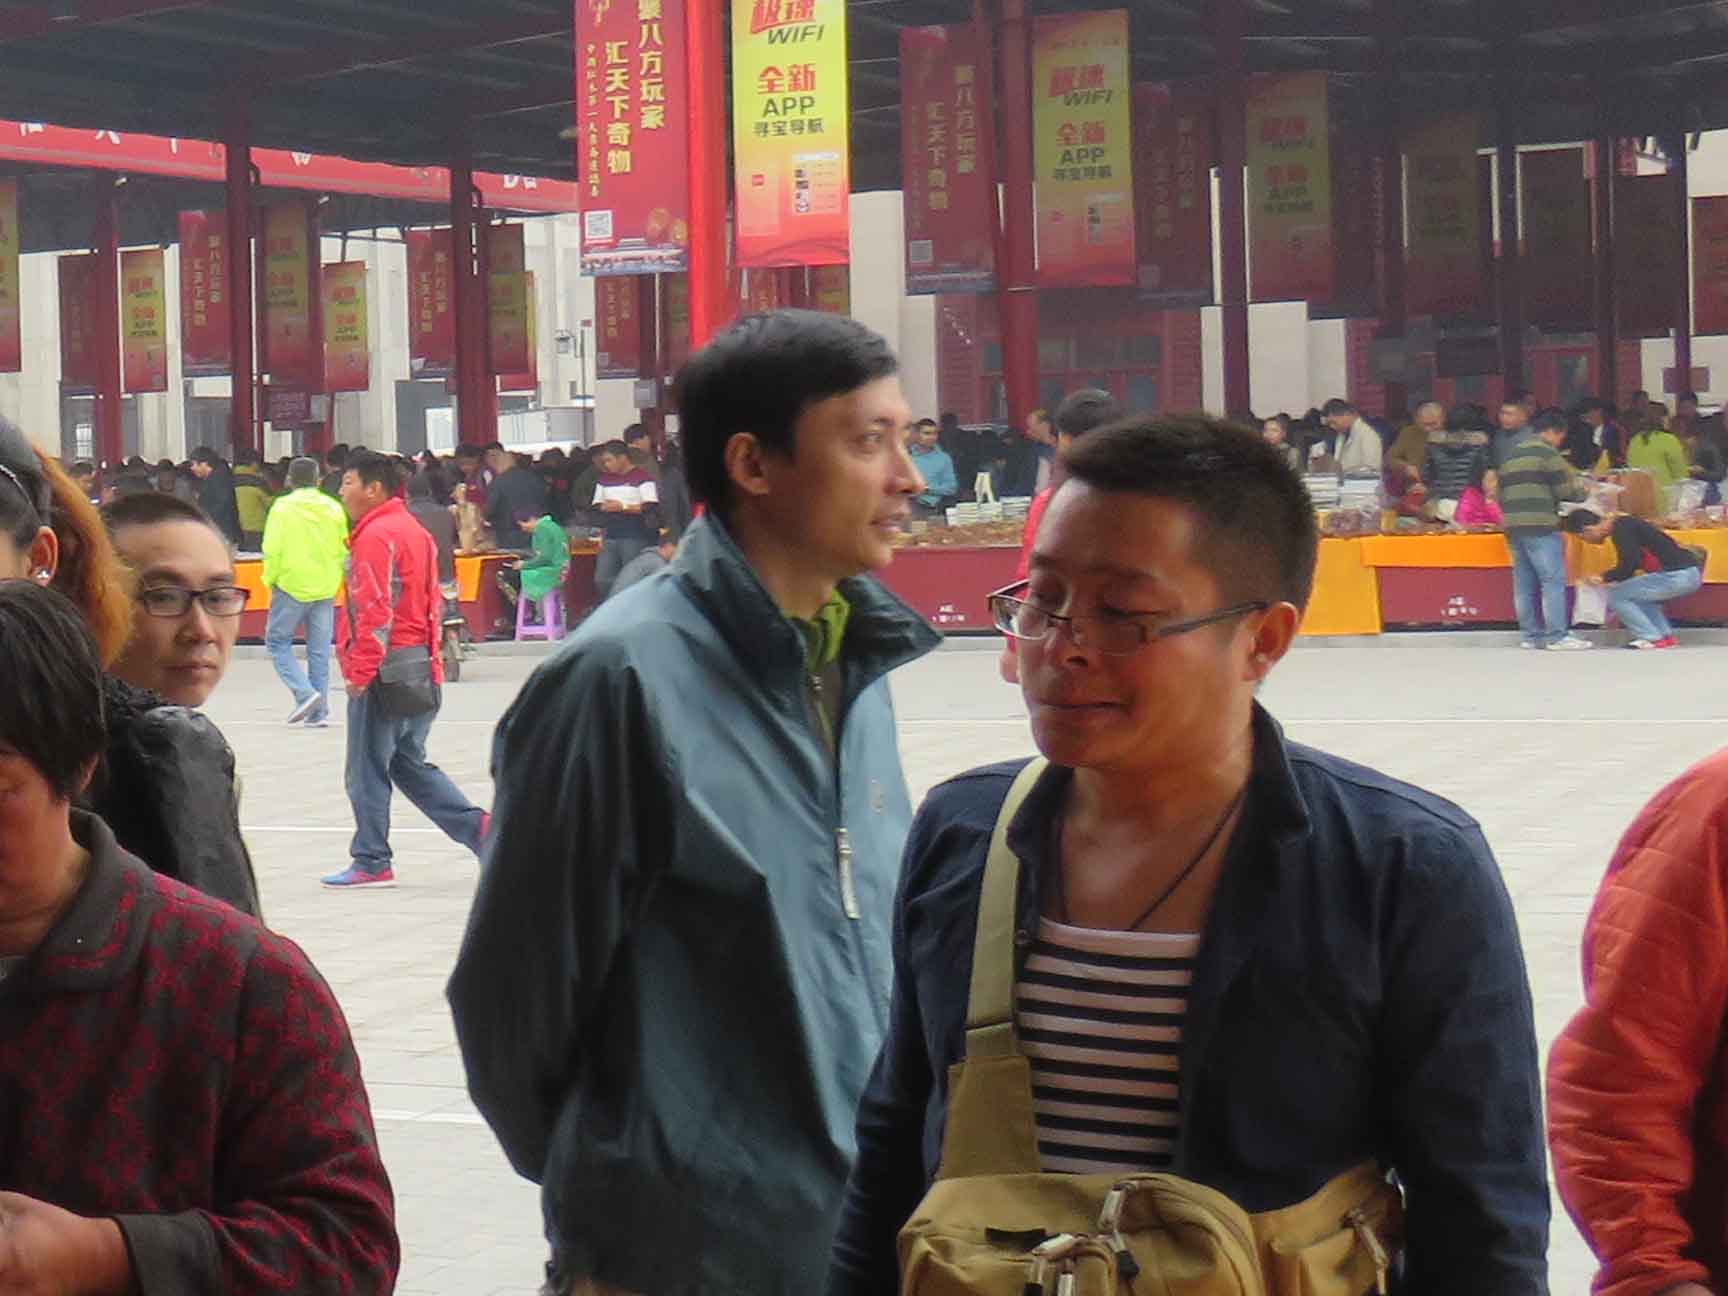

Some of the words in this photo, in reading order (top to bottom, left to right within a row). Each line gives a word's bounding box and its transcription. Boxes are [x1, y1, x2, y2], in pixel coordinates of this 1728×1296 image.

[766, 24, 825, 46] WIFI
[757, 63, 817, 95] 全新
[605, 39, 632, 175] 汇天下奇物
[762, 95, 816, 117] APP
[1058, 147, 1105, 166] APP
